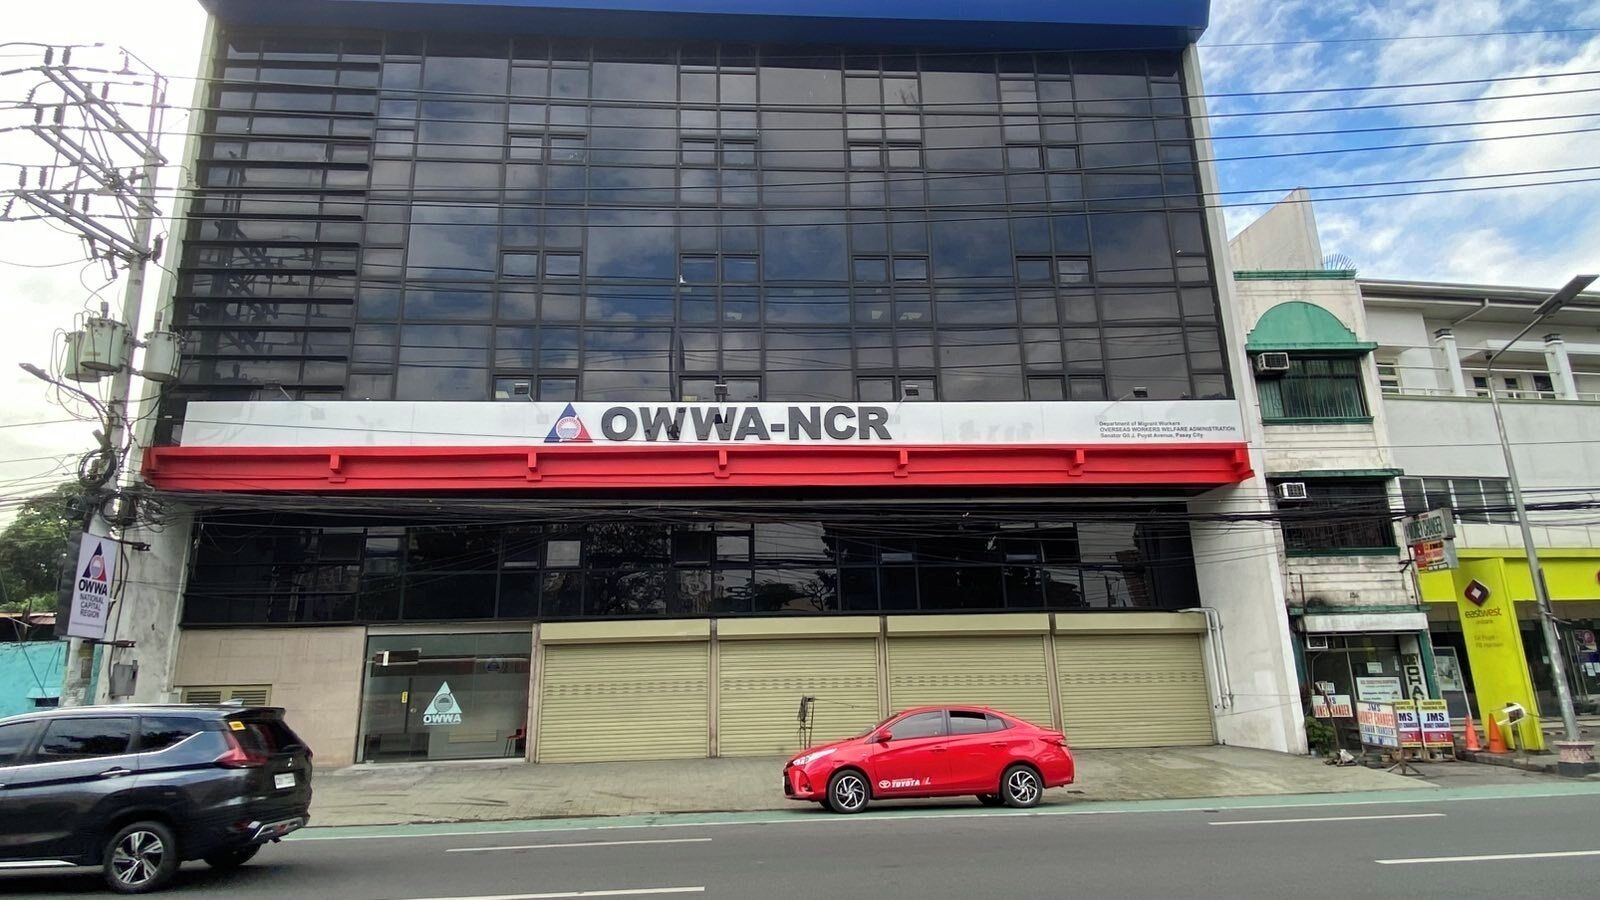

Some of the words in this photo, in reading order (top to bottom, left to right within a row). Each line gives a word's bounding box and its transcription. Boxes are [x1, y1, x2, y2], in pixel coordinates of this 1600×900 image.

[601, 405, 893, 441] OWWA-NCR
[78, 579, 108, 596] OWWA
[79, 593, 104, 604] NATIONAL
[80, 601, 101, 611] CAPITAL
[79, 608, 100, 618] REGION
[1464, 606, 1502, 618] eastwest
[1367, 703, 1381, 712] JMS
[423, 714, 462, 723] OWWA
[1398, 712, 1413, 722] MS
[1426, 712, 1445, 722] JMS
[891, 780, 921, 788] TOYOTA
